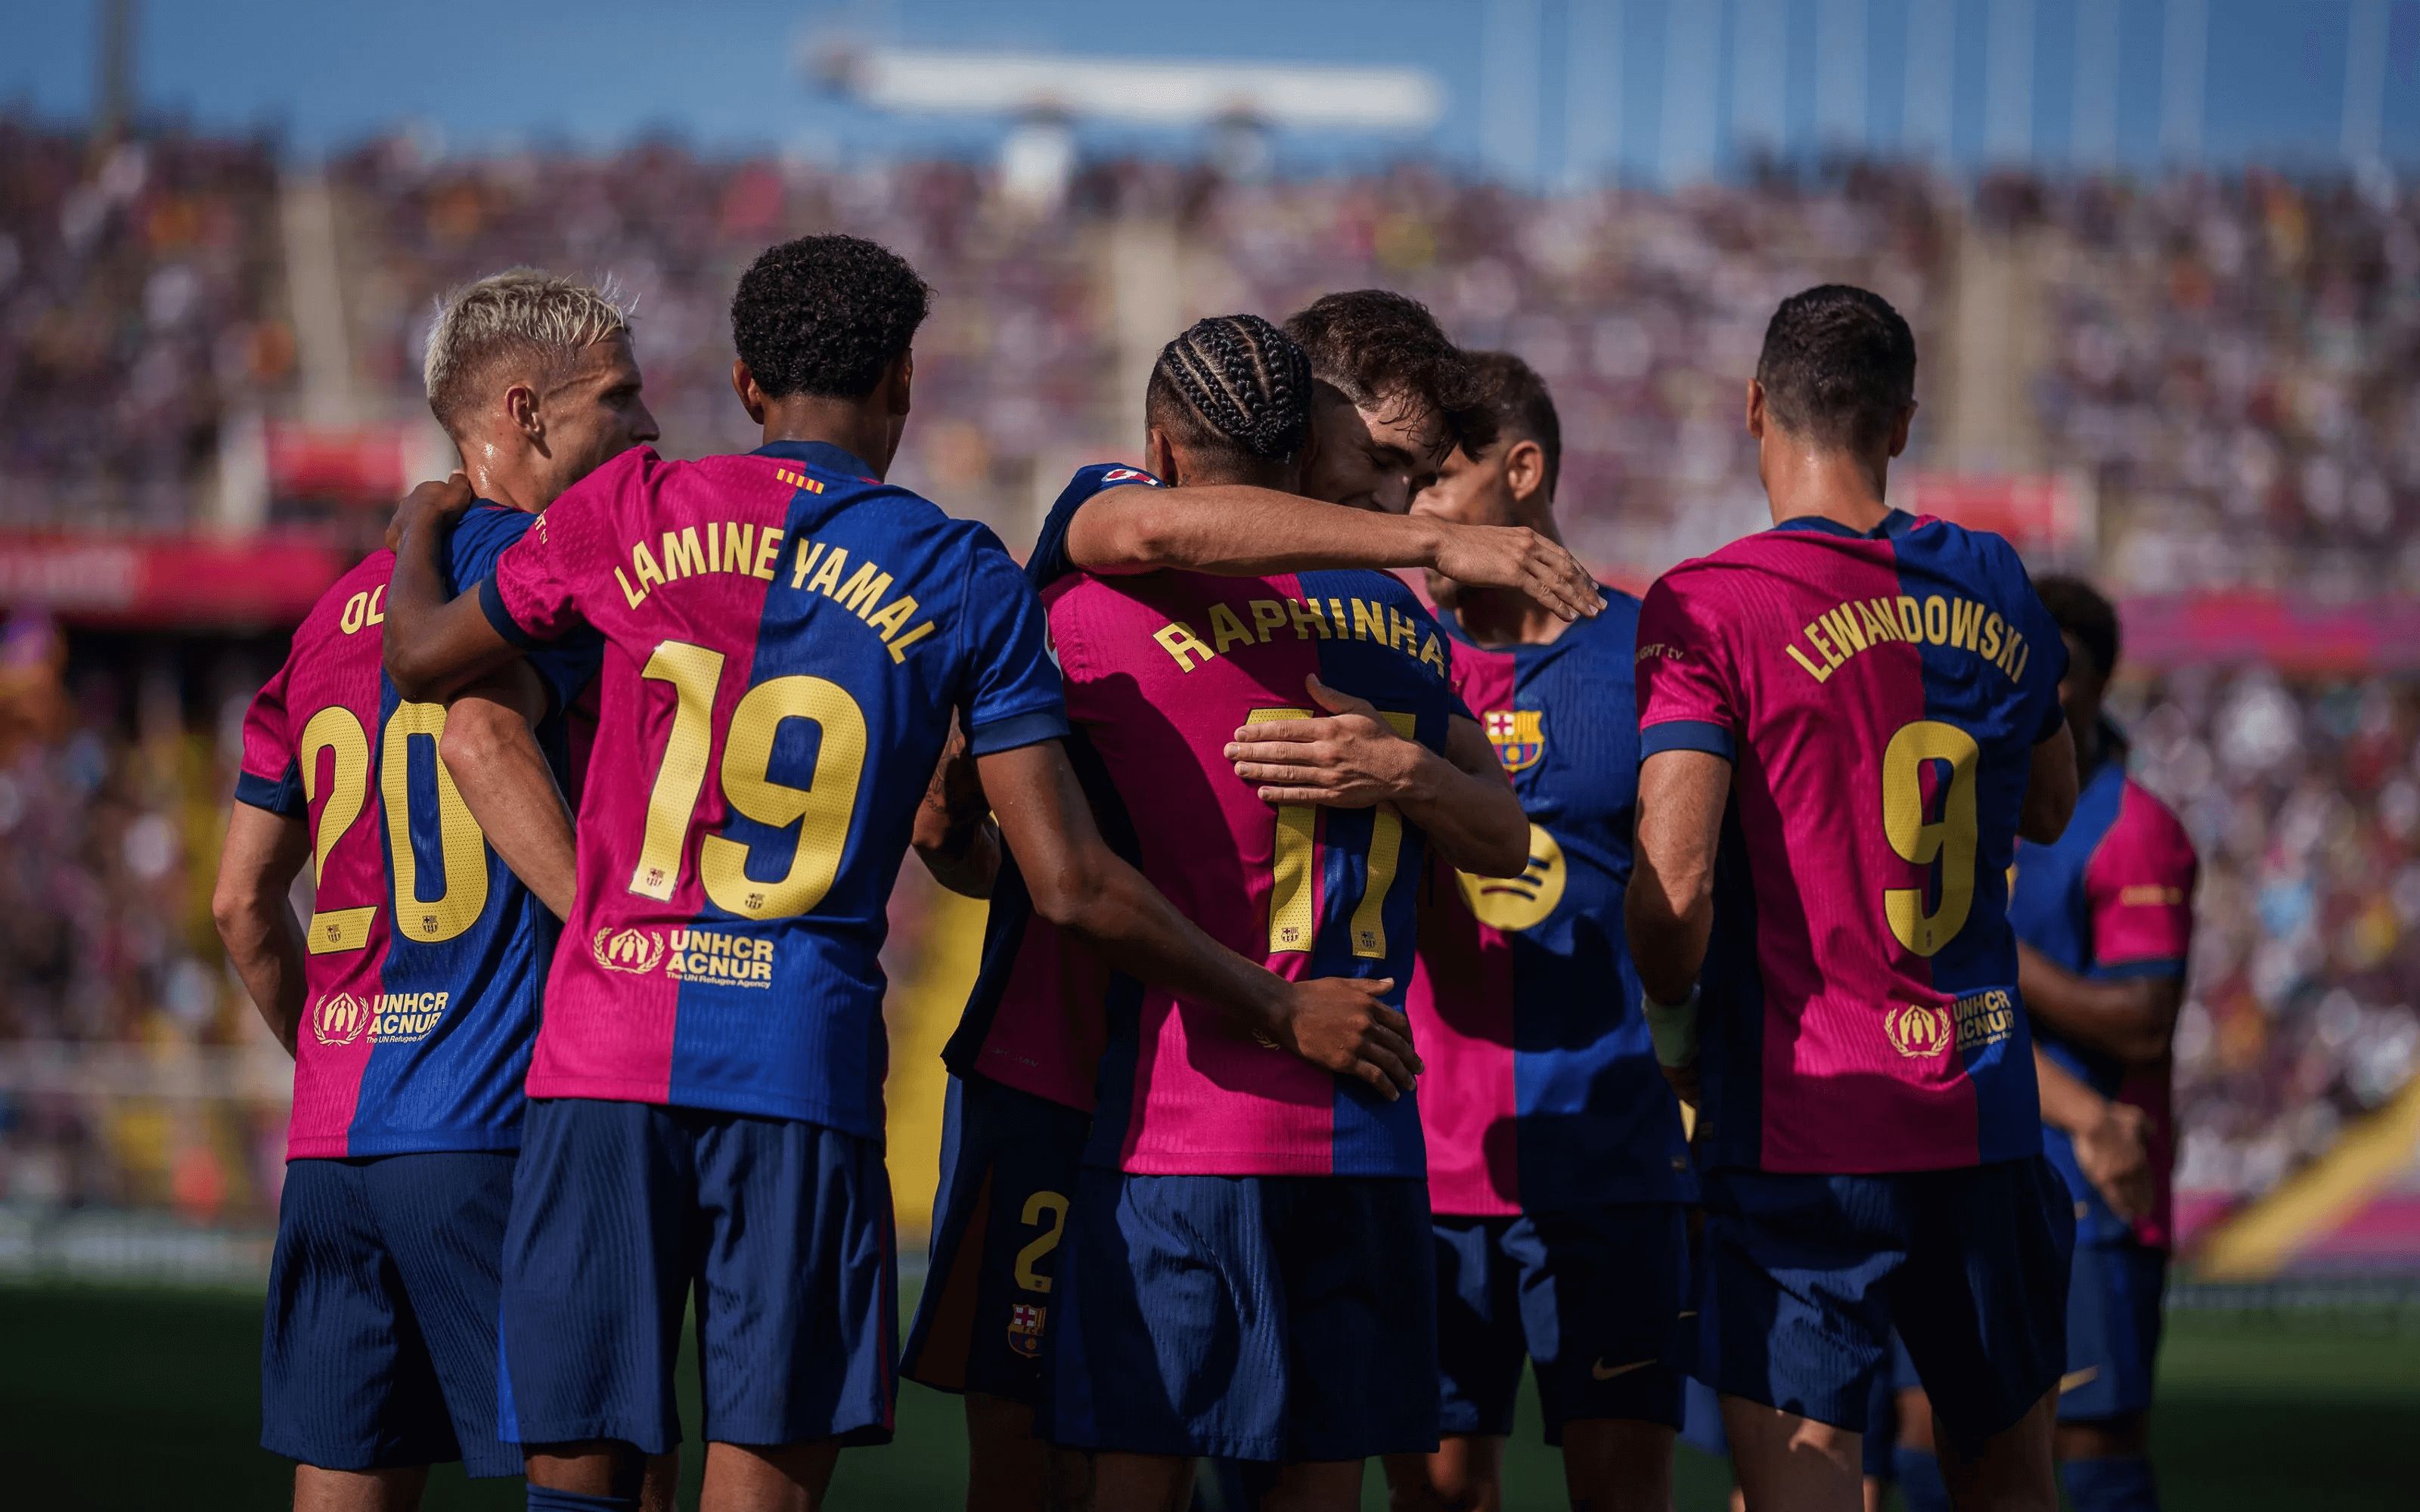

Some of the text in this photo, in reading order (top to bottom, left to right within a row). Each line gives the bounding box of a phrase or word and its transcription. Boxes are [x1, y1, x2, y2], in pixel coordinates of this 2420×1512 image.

[613, 522, 935, 665] LAMINE YAMAL
[1152, 597, 1445, 679] RAPHINHA
[1786, 595, 2029, 684] LEWANDOWSKI
[628, 639, 867, 921] 19
[300, 698, 489, 956] 20
[1882, 720, 1980, 958] 9
[670, 929, 774, 962] UNHCR
[666, 950, 772, 981] ACNUR
[666, 971, 771, 990] The UN Refugee Agency
[373, 992, 449, 1015] UNHCR
[1952, 989, 2012, 1023] UNHCR
[366, 1036, 378, 1044] The
[378, 1035, 390, 1043] UN
[389, 1035, 417, 1043] Refugee
[368, 1012, 442, 1036] ACNUR
[1956, 1009, 2015, 1045] ACNUR
[1014, 1191, 1069, 1294] 2
